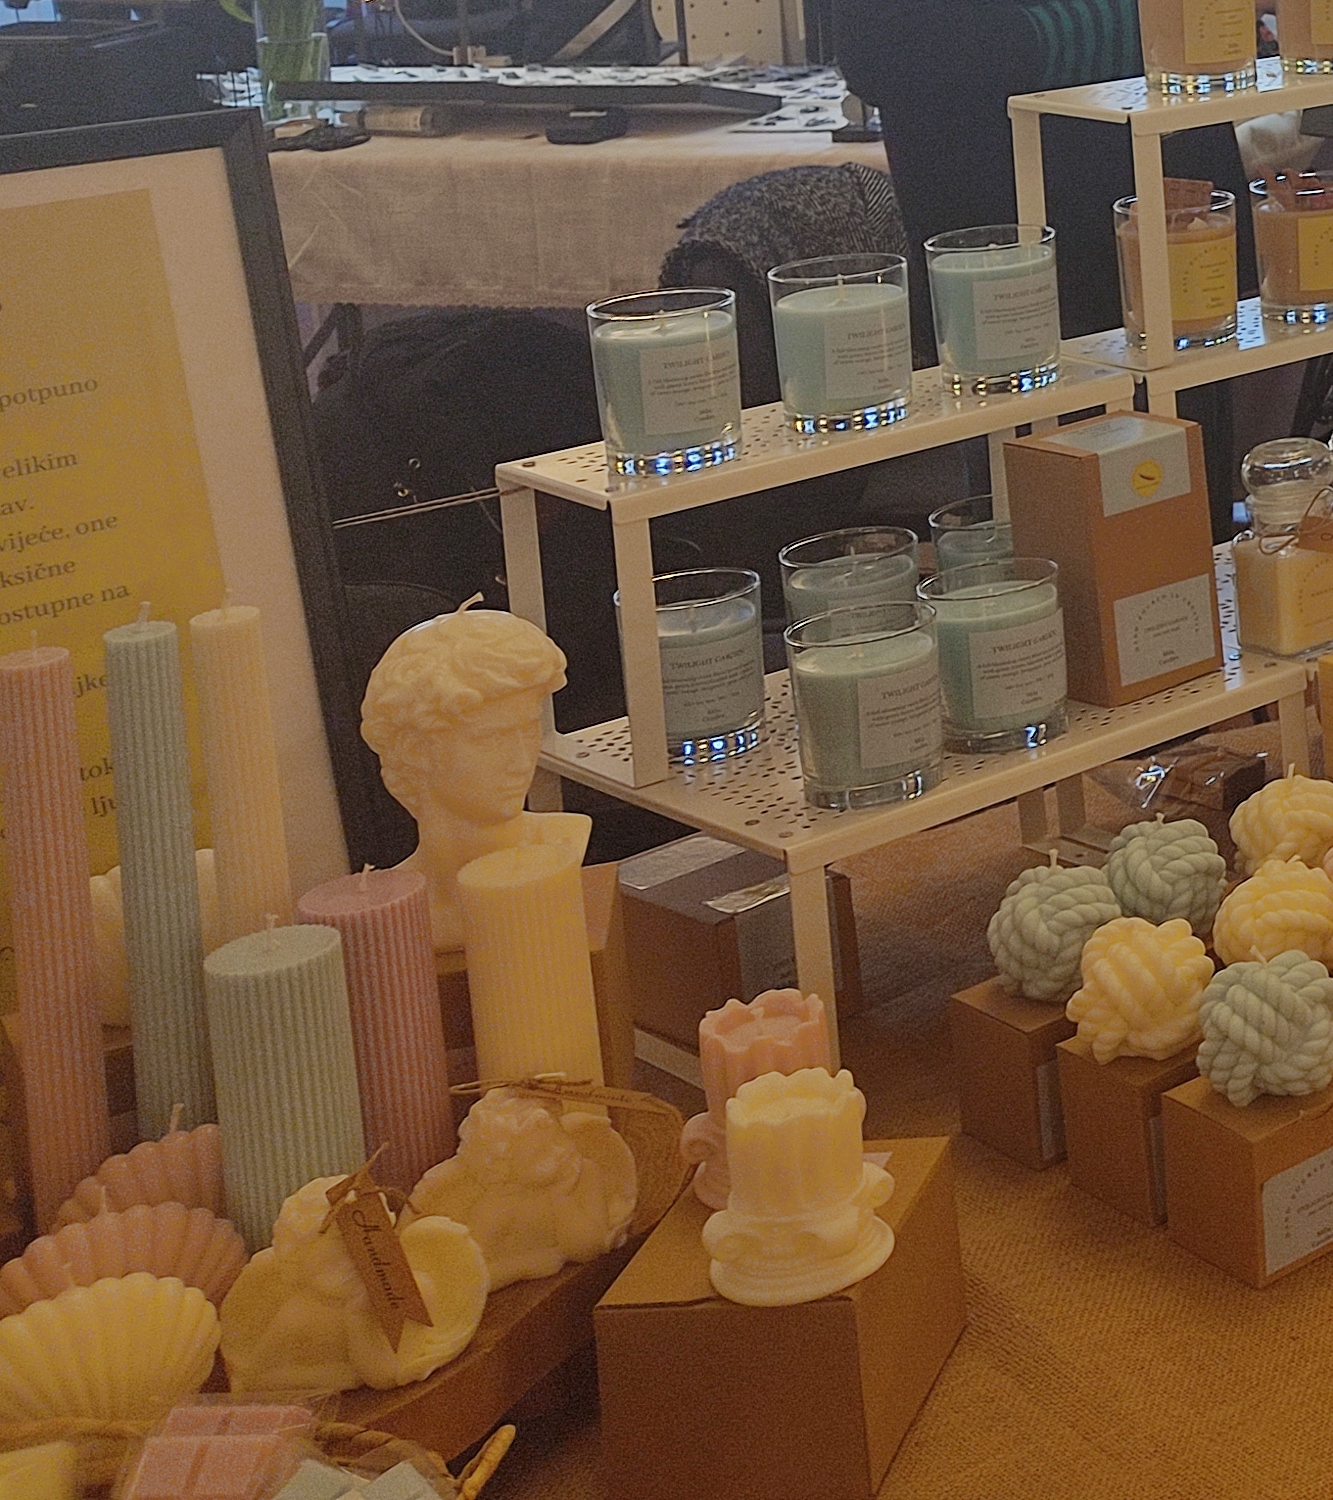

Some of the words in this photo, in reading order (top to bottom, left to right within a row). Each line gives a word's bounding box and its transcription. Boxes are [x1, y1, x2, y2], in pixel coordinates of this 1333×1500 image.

[0, 379, 98, 412] potpuno
[75, 516, 118, 536] one
[101, 584, 130, 602] na
[352, 1209, 405, 1309] Handmade
